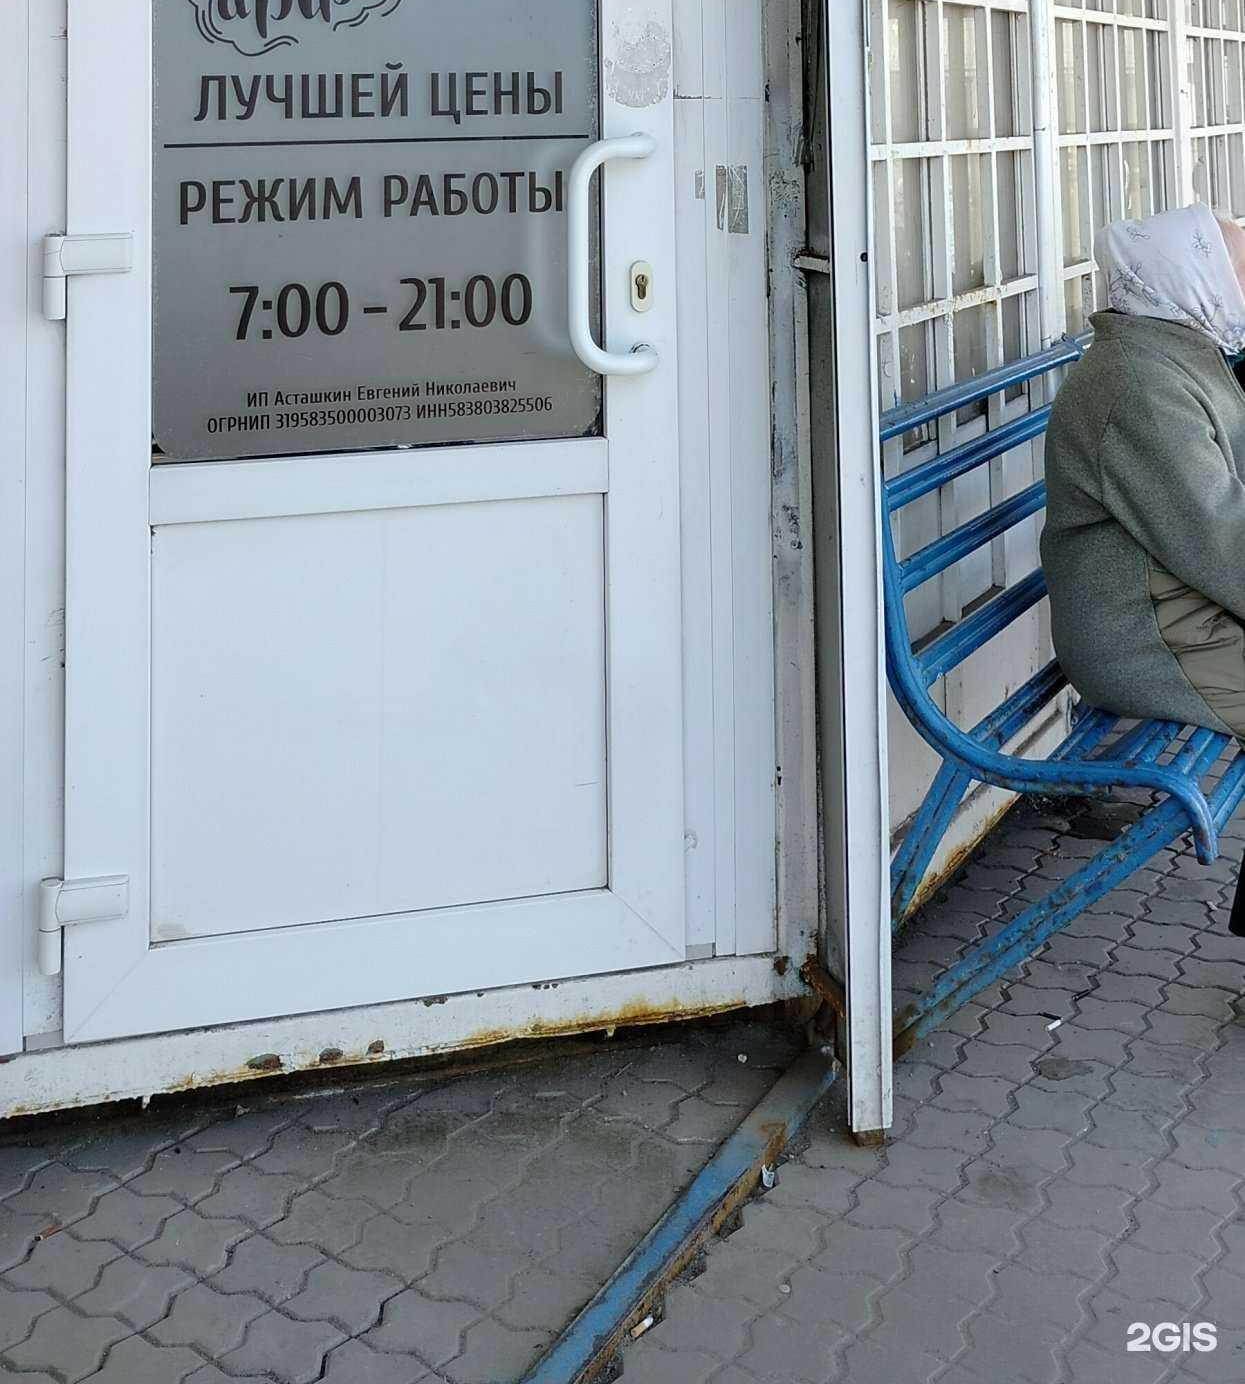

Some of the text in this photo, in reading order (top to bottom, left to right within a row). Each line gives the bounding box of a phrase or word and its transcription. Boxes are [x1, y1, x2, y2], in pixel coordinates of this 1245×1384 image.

[193, 62, 564, 124] ЛУЧШЕЙ ЦЕНЫ
[178, 171, 564, 225] РЕЖИМ РАБОТЫ
[229, 281, 349, 341] 7:00
[398, 273, 533, 332] 21:00
[207, 414, 271, 433] ОГРНИП
[275, 405, 412, 430] 319583500003073
[247, 379, 517, 408] ИП Асташкин Евгений Николаевич
